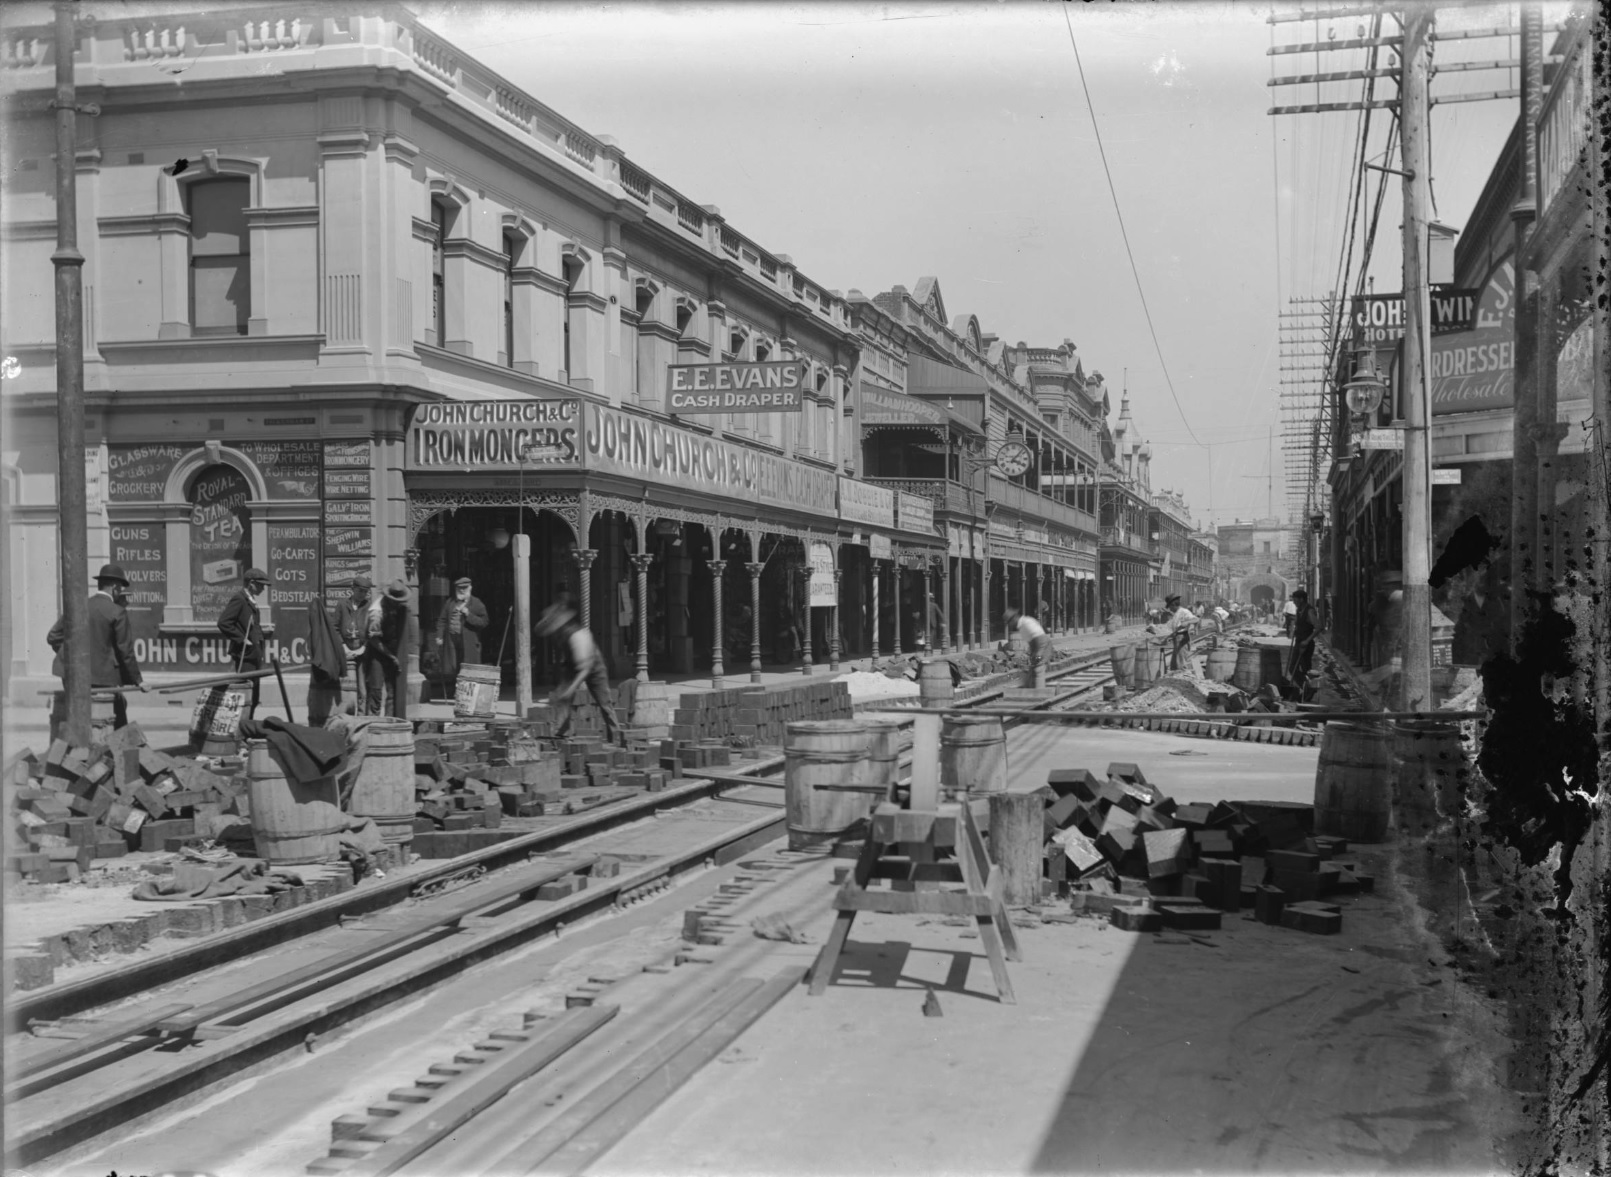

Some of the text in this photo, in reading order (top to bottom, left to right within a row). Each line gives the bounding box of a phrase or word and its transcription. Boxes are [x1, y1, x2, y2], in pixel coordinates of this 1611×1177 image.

[1357, 299, 1406, 327] JOH
[1431, 341, 1515, 378] RDRESSE
[672, 393, 798, 408] CASH DRAPER.
[415, 403, 468, 424] JOHN
[470, 402, 547, 424] CHURCH
[548, 407, 559, 422] &
[255, 442, 320, 452] WHOLESALE
[587, 404, 648, 470] JOHN
[650, 420, 728, 483] CHURCH
[730, 452, 741, 486] &
[109, 445, 183, 470] GLASSWARE
[256, 453, 320, 464] DEPARTMENT
[272, 465, 319, 477] OFFICES
[109, 480, 164, 497] CROCKERY
[196, 476, 236, 503] ROYAL
[192, 492, 247, 526] STANDARD
[350, 502, 370, 512] IRON
[111, 527, 150, 541] GUNS
[204, 514, 245, 542] TEA
[325, 530, 360, 545] SHERWIN
[337, 539, 372, 553] WILLIAMS
[116, 547, 162, 562] RIFLES
[271, 548, 317, 560] GO-CARTS
[124, 570, 168, 582] VOLVERS
[275, 568, 308, 581] COTS
[133, 637, 178, 664] OHN
[185, 637, 280, 664] CHUH
[280, 646, 292, 664] &
